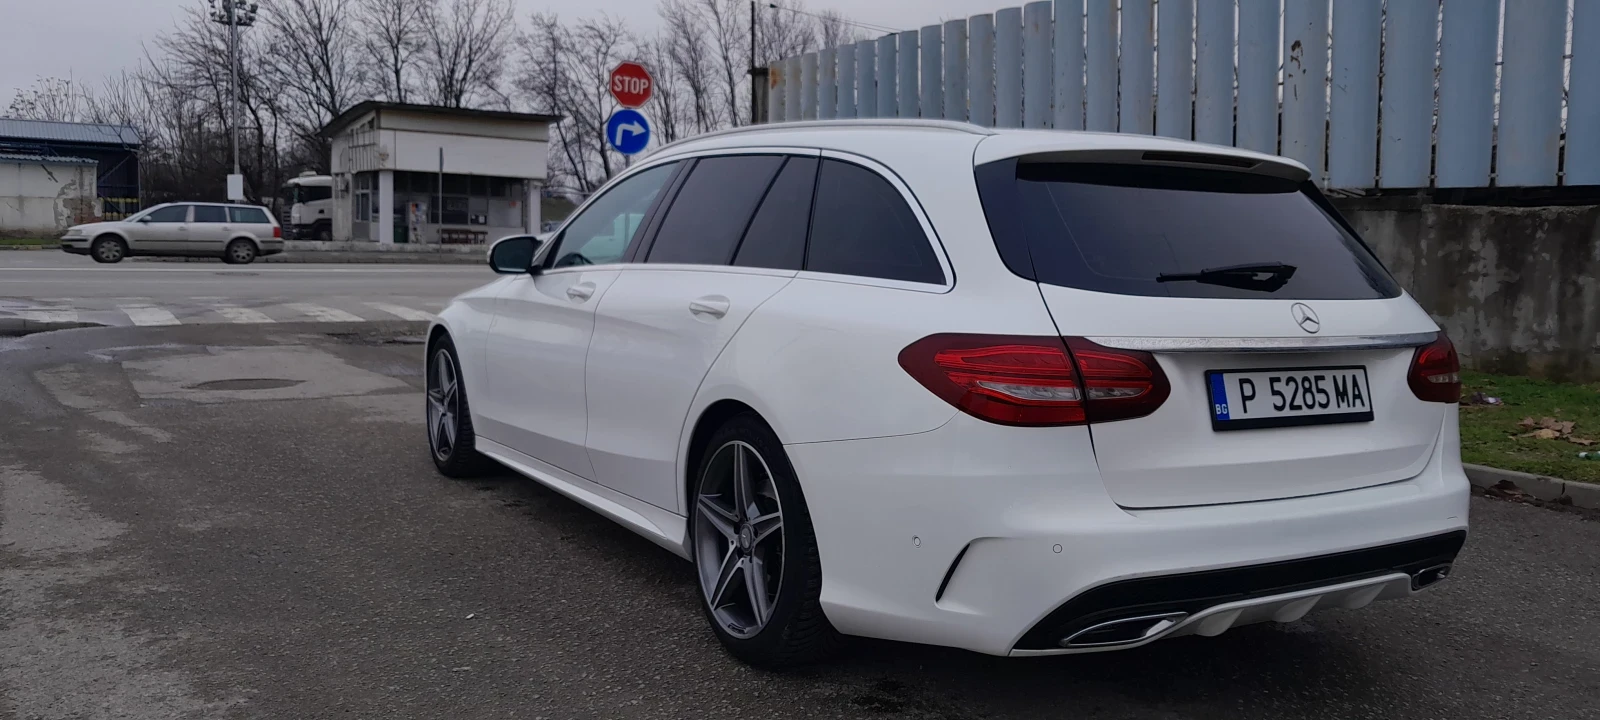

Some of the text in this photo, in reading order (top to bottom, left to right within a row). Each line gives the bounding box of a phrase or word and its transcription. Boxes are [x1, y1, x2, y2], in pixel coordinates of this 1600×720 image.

[613, 75, 649, 95] STOP
[1239, 374, 1366, 413] P 5285 MA
[1215, 404, 1227, 414] BG
